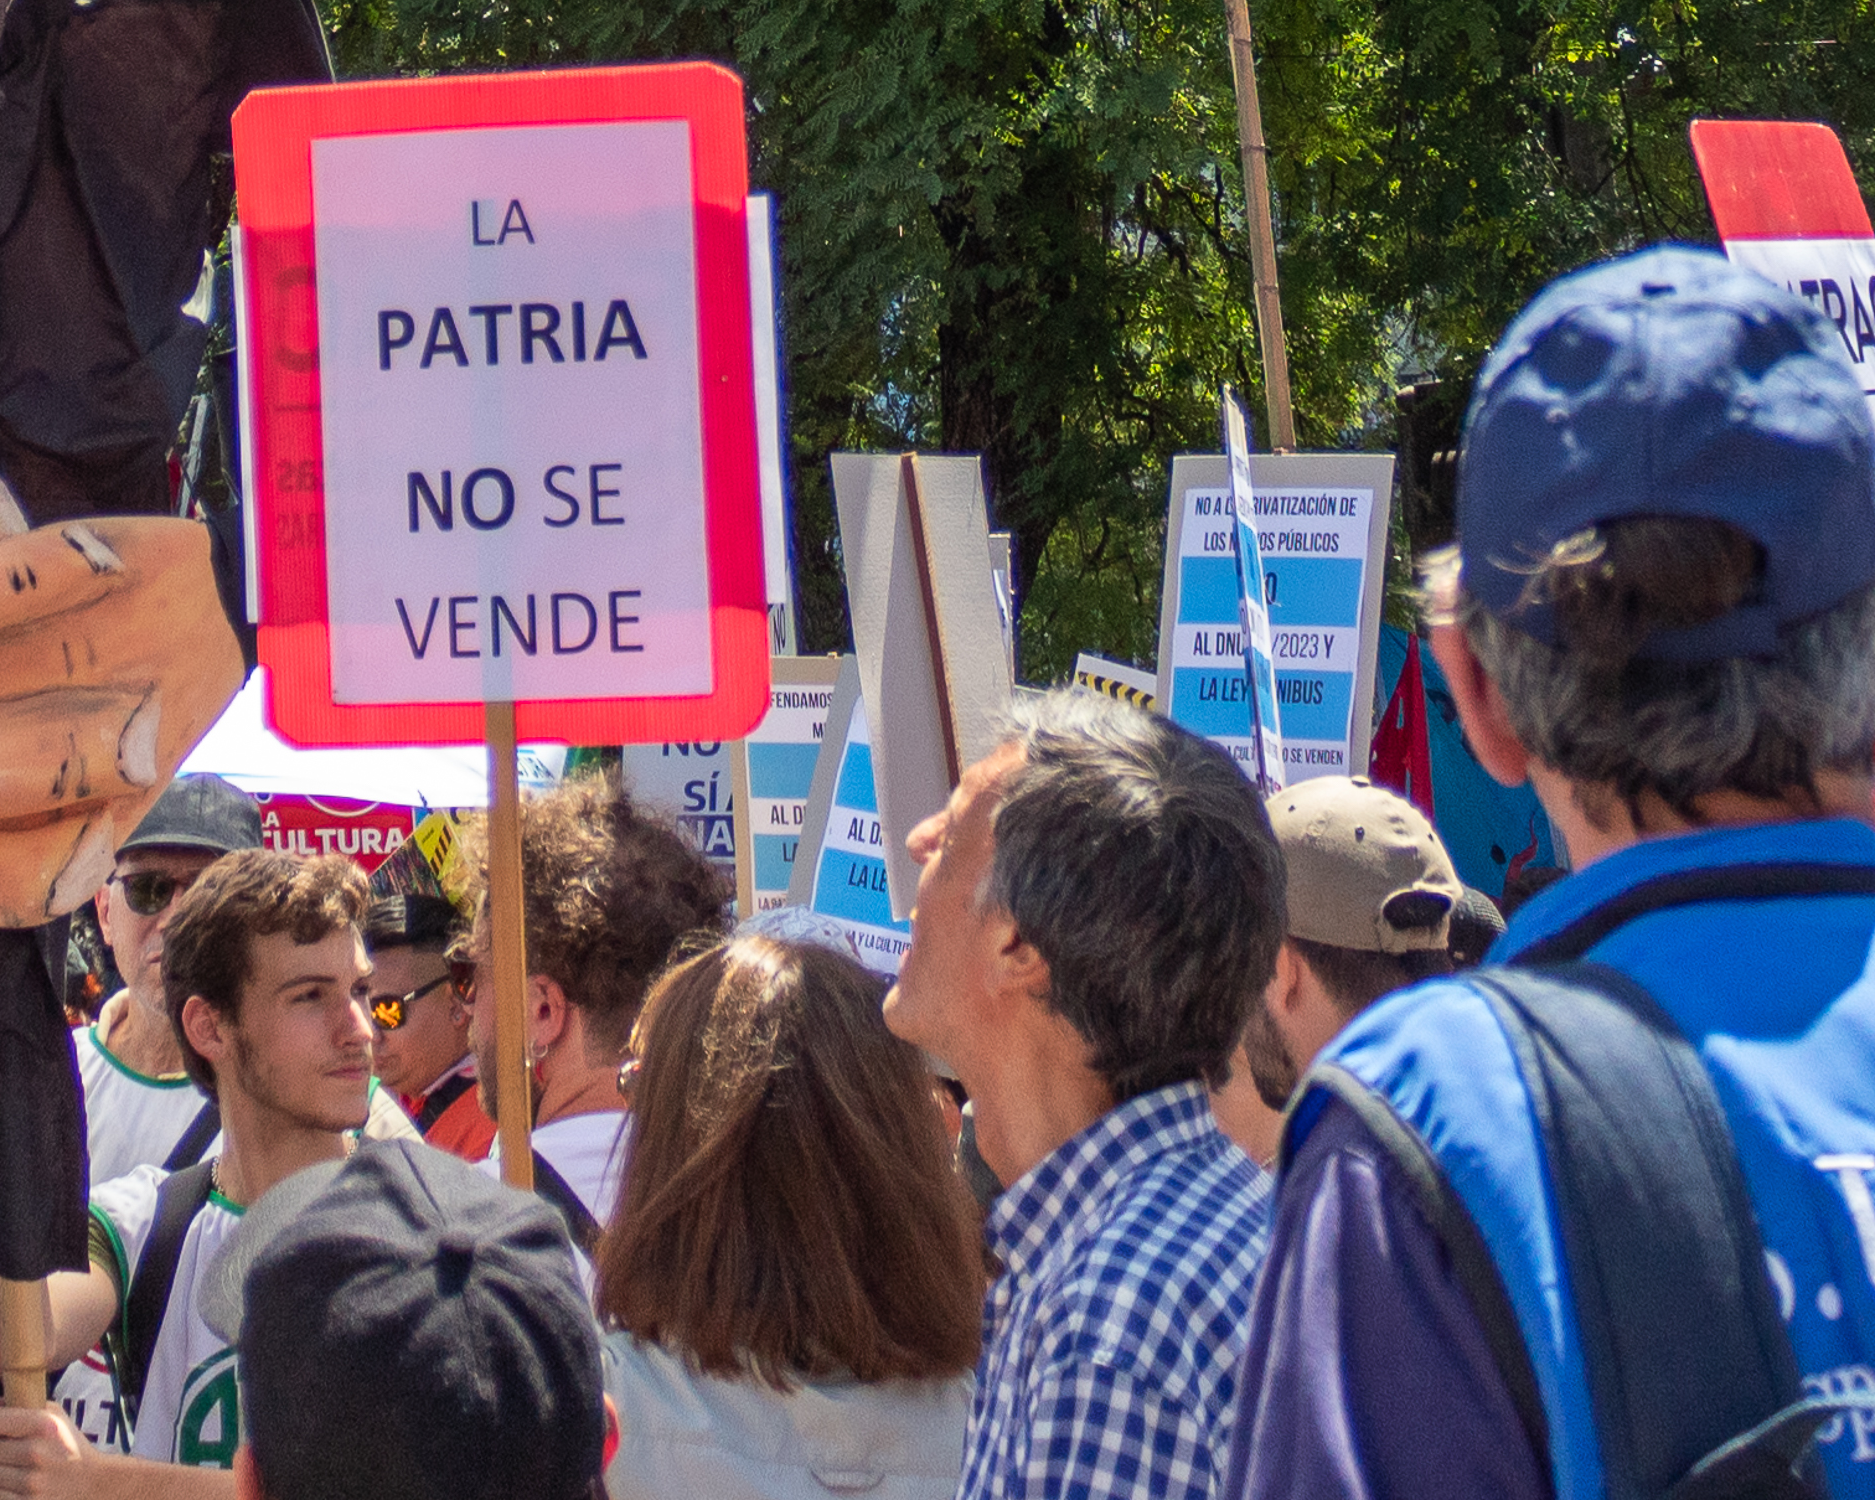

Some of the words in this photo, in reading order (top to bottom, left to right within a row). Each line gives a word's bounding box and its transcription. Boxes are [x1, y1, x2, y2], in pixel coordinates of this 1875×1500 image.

[471, 199, 535, 247] LA
[377, 299, 648, 371] PATRIA
[407, 467, 516, 533] NO
[543, 463, 626, 529] SE
[1195, 496, 1211, 515] NO
[1213, 496, 1222, 515] A
[1254, 492, 1337, 516] RIVATIZACIÓN
[1340, 496, 1358, 516] DE
[1204, 531, 1226, 551] LOS
[1278, 528, 1339, 552] PÚBLICOS
[394, 589, 644, 659] VENDE
[1193, 631, 1211, 656] AL
[1323, 633, 1335, 659] Y
[1200, 677, 1217, 701] LA
[683, 770, 721, 812] SÍ
[770, 804, 790, 825] AL
[847, 817, 865, 843] AL
